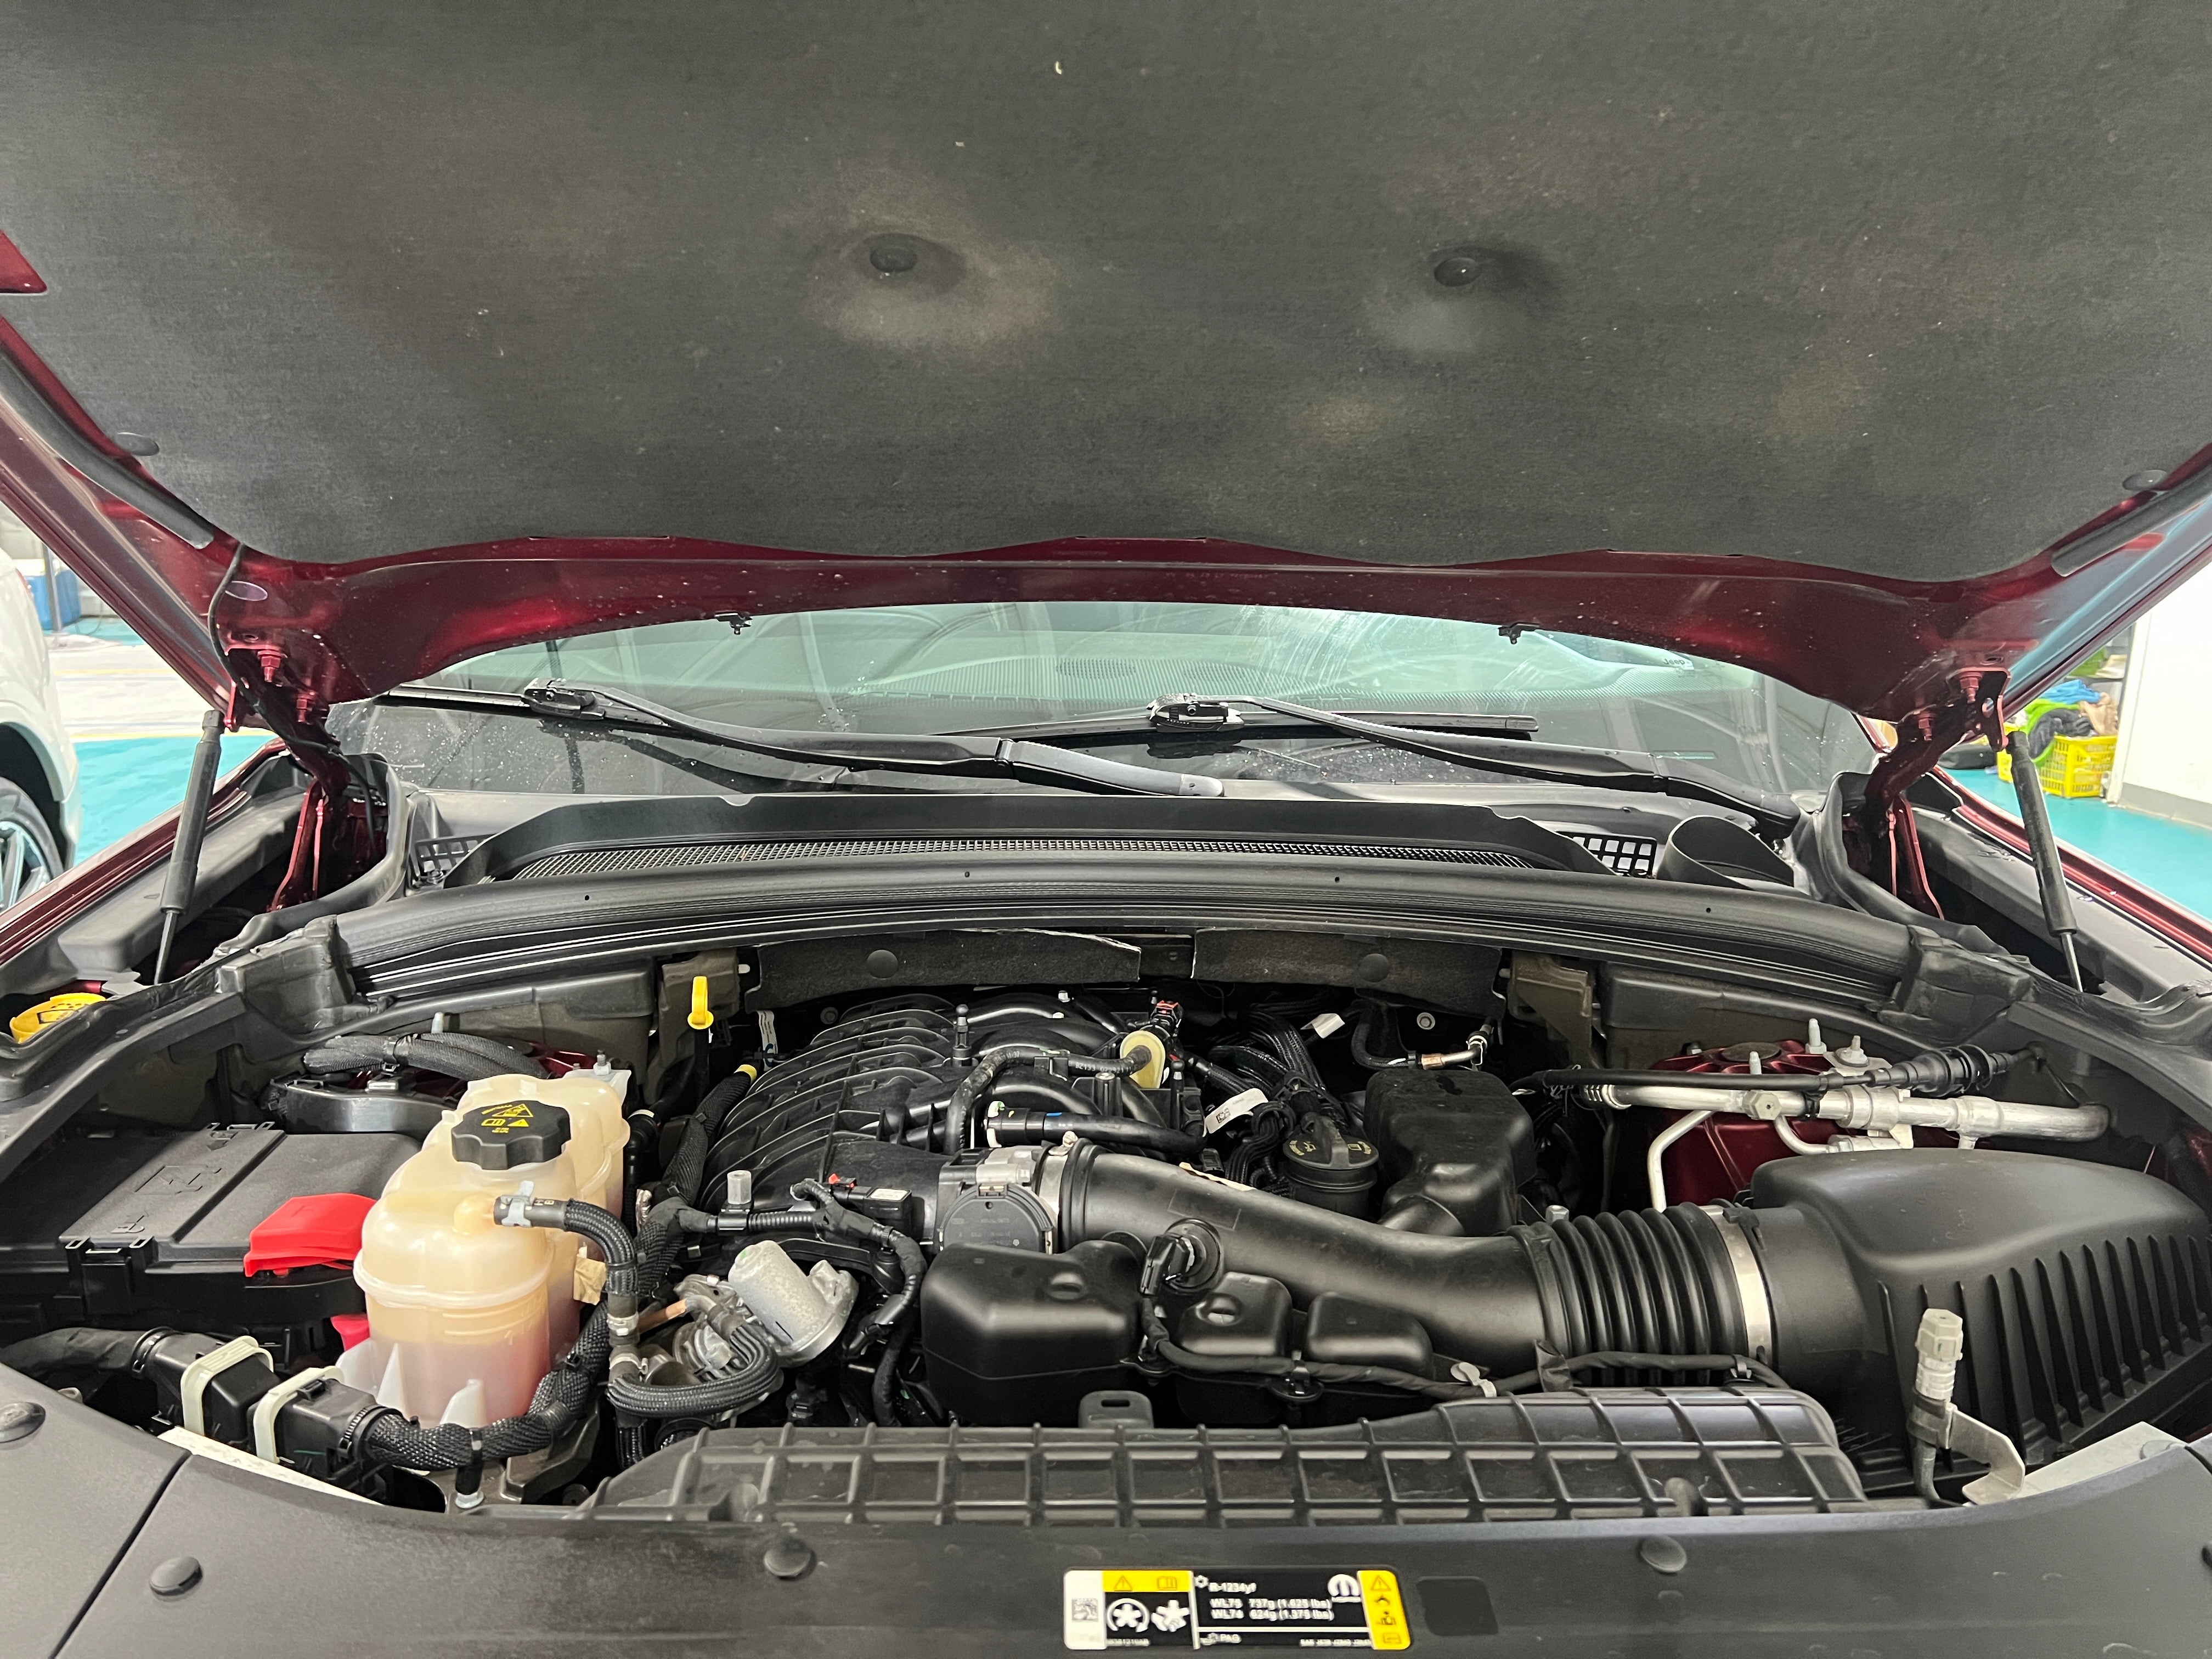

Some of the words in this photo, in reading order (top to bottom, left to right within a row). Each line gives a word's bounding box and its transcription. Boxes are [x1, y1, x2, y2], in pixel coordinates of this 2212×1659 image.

[1210, 1598, 1243, 1609] WL75
[1249, 1598, 1276, 1610] 737g
[1277, 1599, 1310, 1609] (1.625
[1311, 1599, 1332, 1610] lbs)
[1312, 1610, 1335, 1621] lbs)
